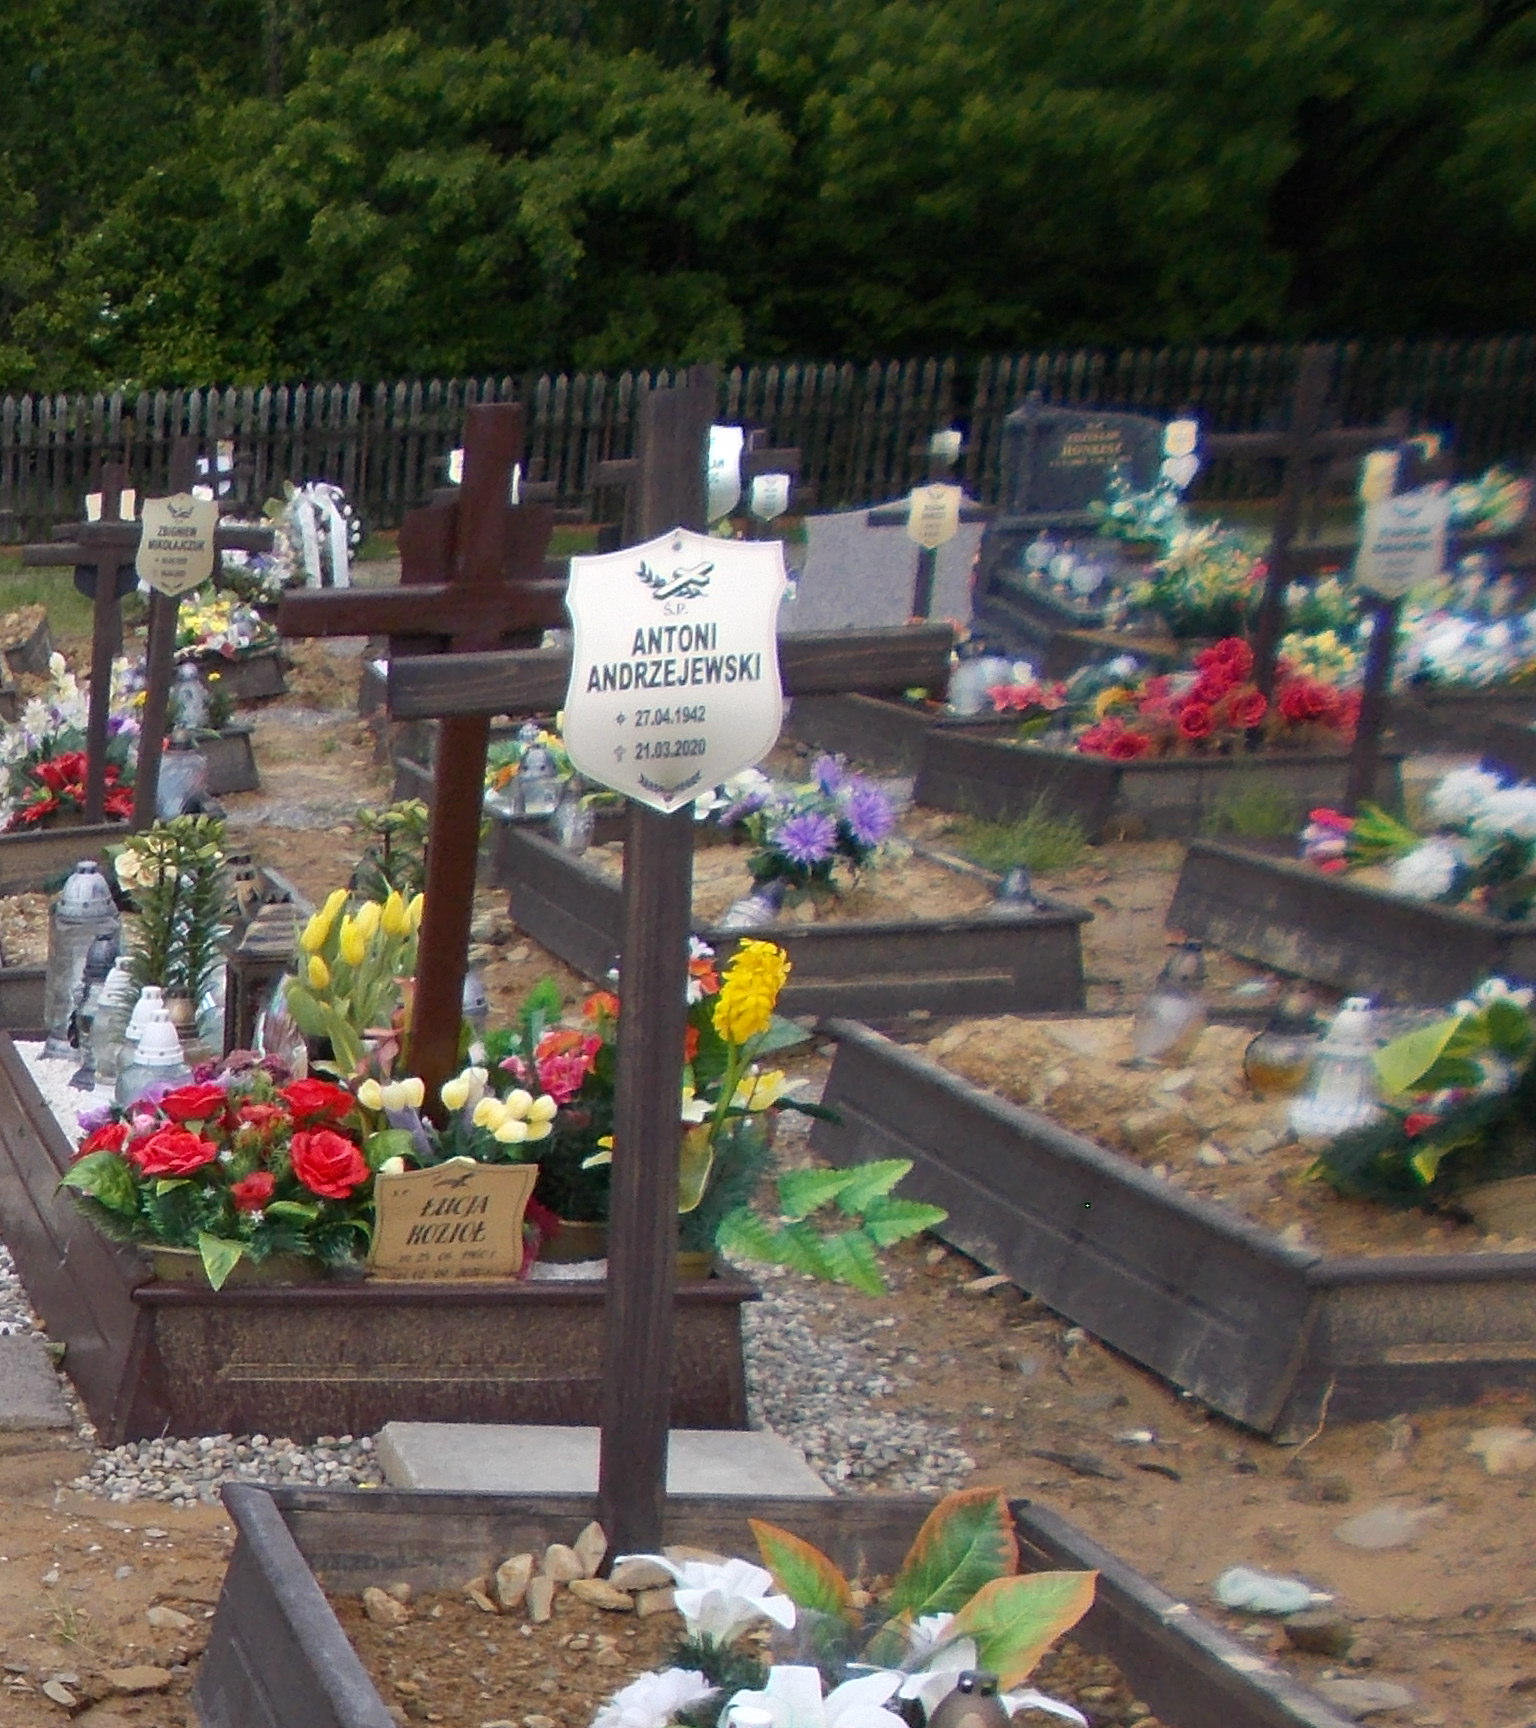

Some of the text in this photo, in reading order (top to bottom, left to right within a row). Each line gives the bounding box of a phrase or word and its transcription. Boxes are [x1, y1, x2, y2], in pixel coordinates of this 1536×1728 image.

[631, 622, 717, 656] ANTONI
[586, 652, 761, 693] ANDRZEJEWSKI
[634, 705, 706, 727] 27.04.1942
[635, 738, 706, 760] 21.03.2020
